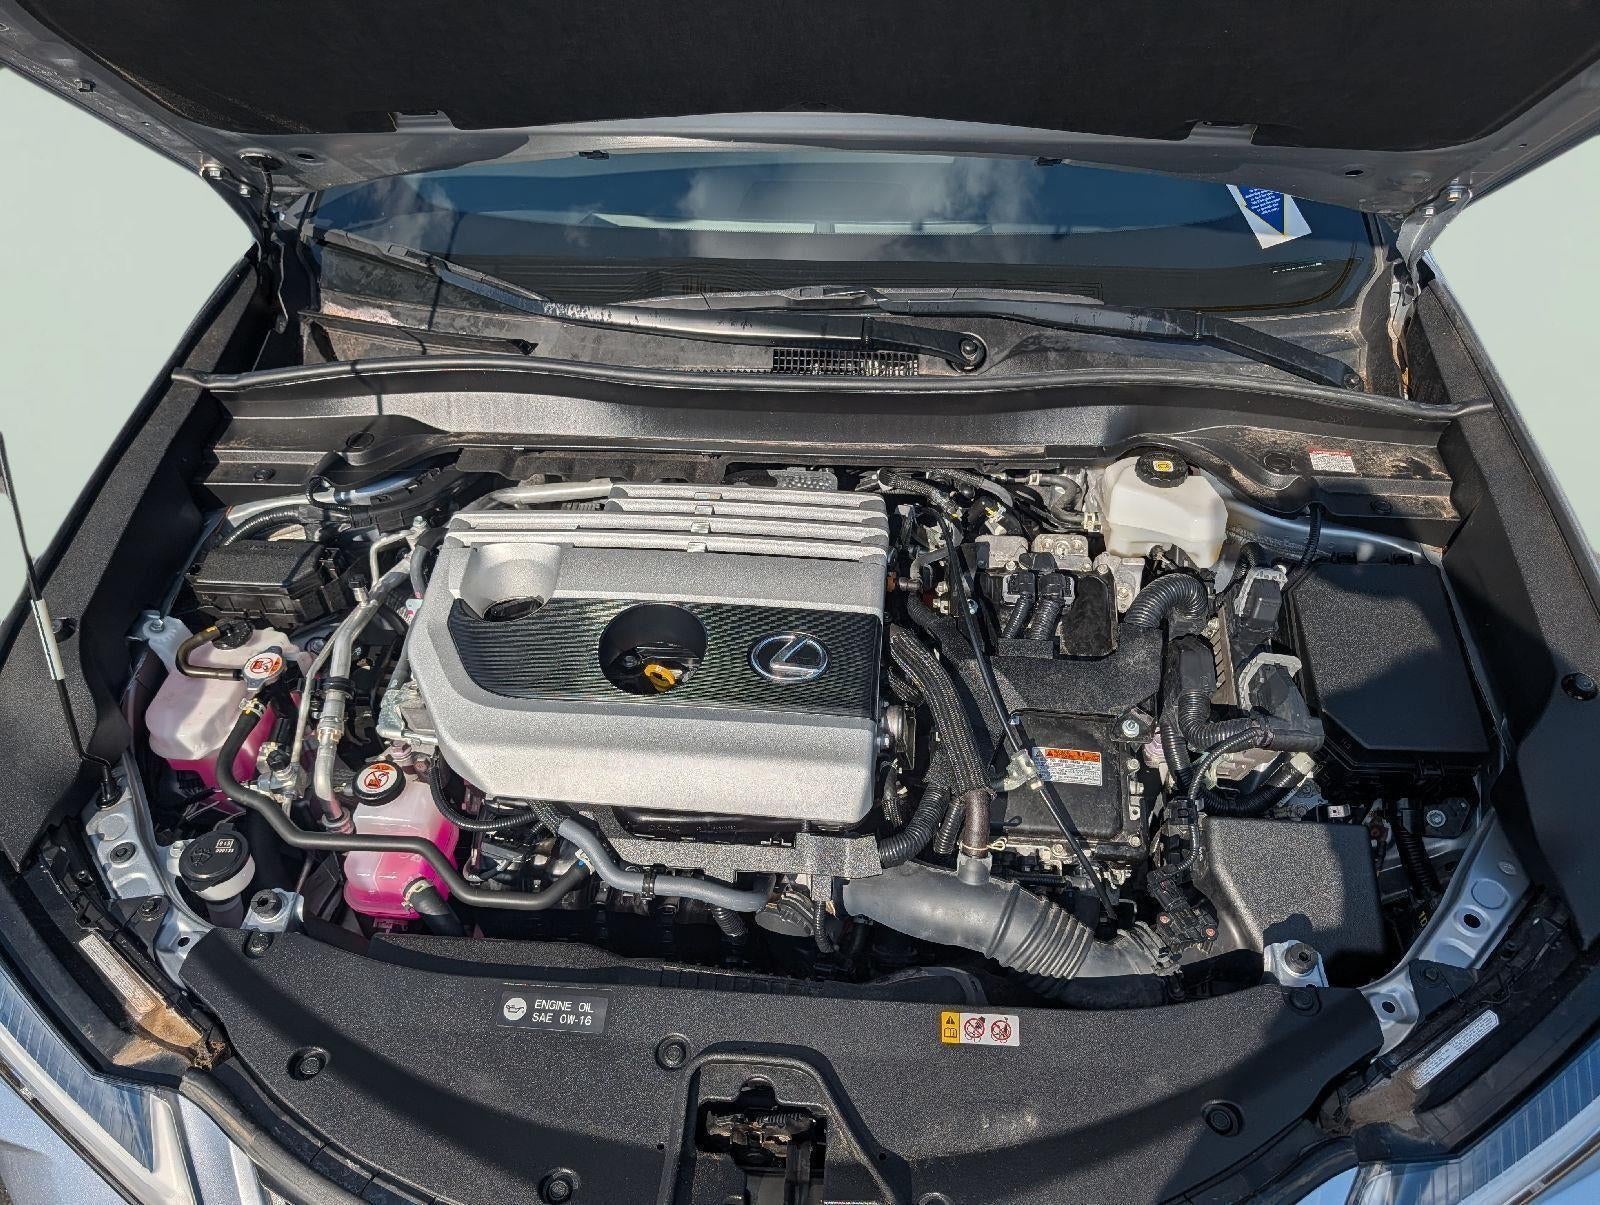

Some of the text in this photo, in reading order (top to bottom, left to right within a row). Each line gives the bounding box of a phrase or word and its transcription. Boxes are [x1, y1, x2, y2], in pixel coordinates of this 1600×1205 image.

[535, 999, 594, 1013] ENGINE OIL
[532, 1012, 553, 1023] SAE
